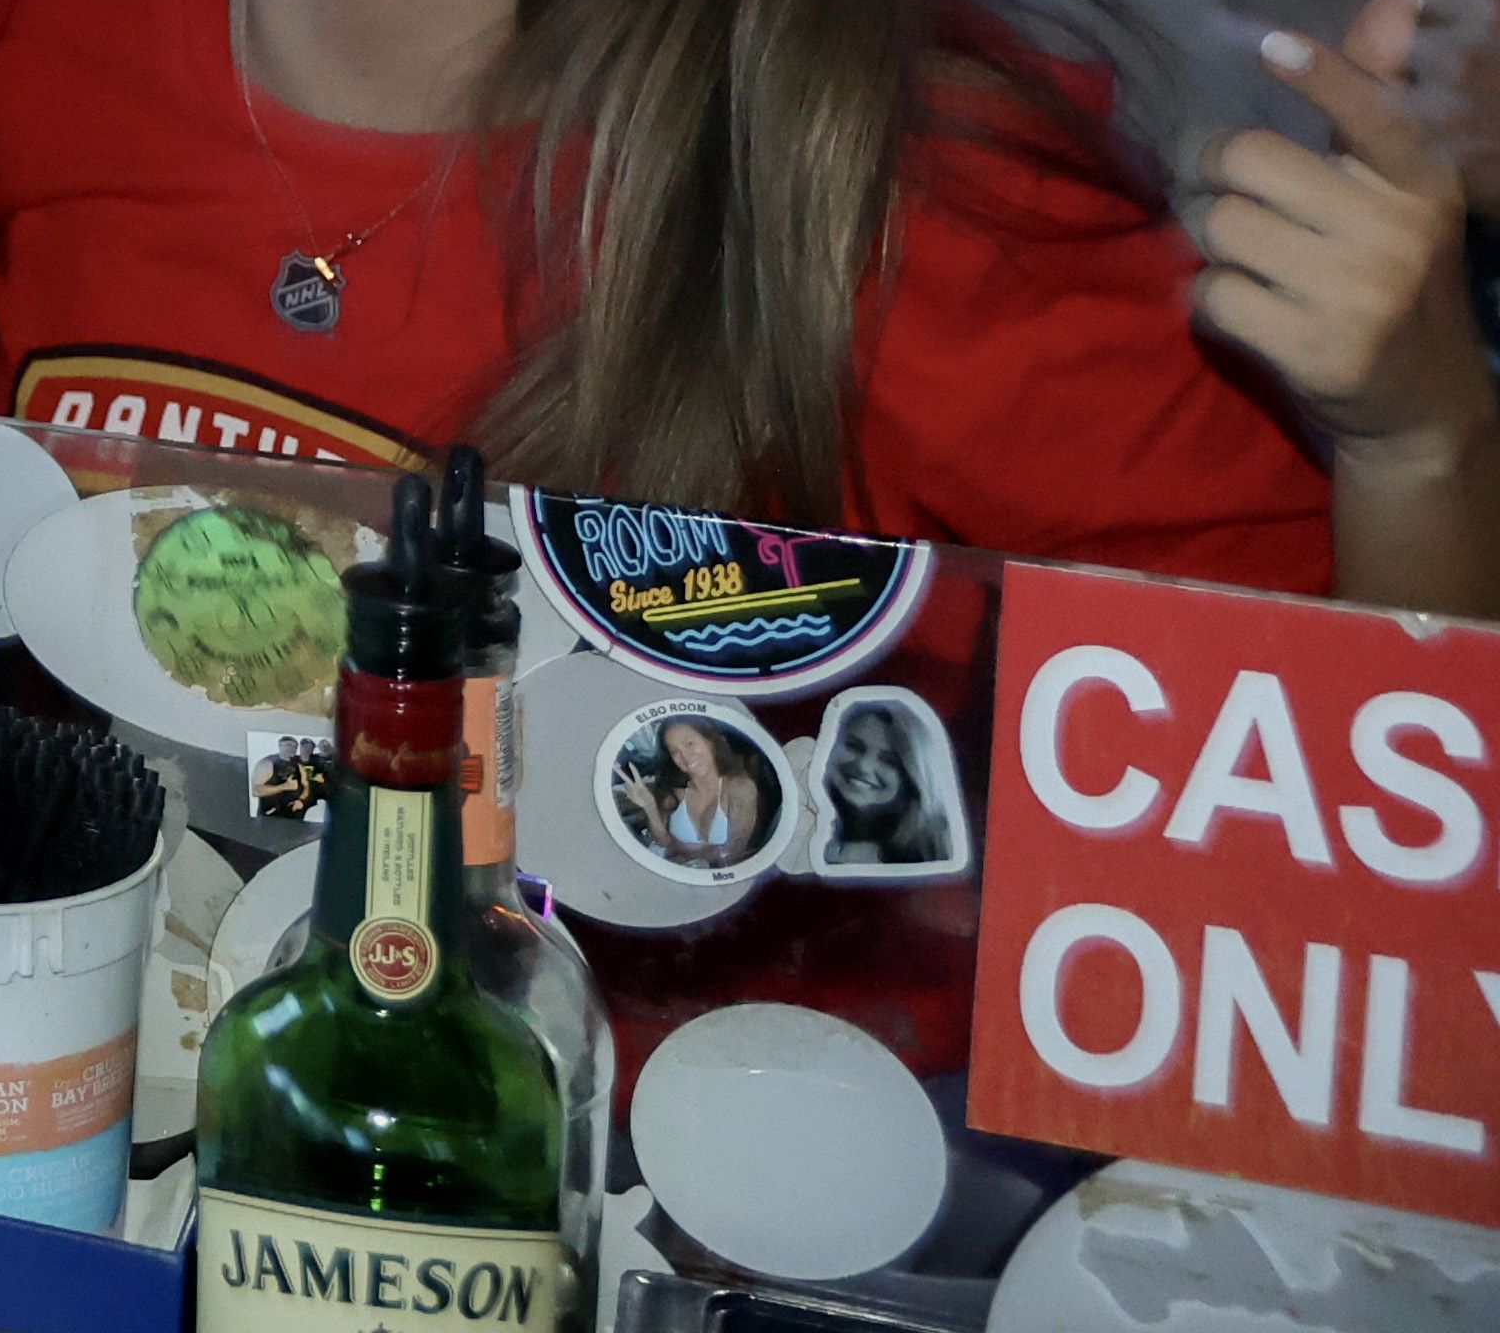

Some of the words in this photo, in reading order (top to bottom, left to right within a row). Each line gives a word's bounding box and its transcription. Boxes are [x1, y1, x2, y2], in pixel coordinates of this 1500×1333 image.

[284, 282, 330, 308] NHL
[574, 500, 729, 582] ROOM
[609, 579, 675, 615] Since
[682, 561, 745, 604] 1938
[635, 704, 668, 724] ELBO
[669, 702, 708, 715] ROOM
[1019, 643, 1500, 890] CAS
[1019, 902, 1500, 1154] ONL
[51, 1084, 89, 1109] BAY
[220, 1229, 543, 1325] JAMESON
